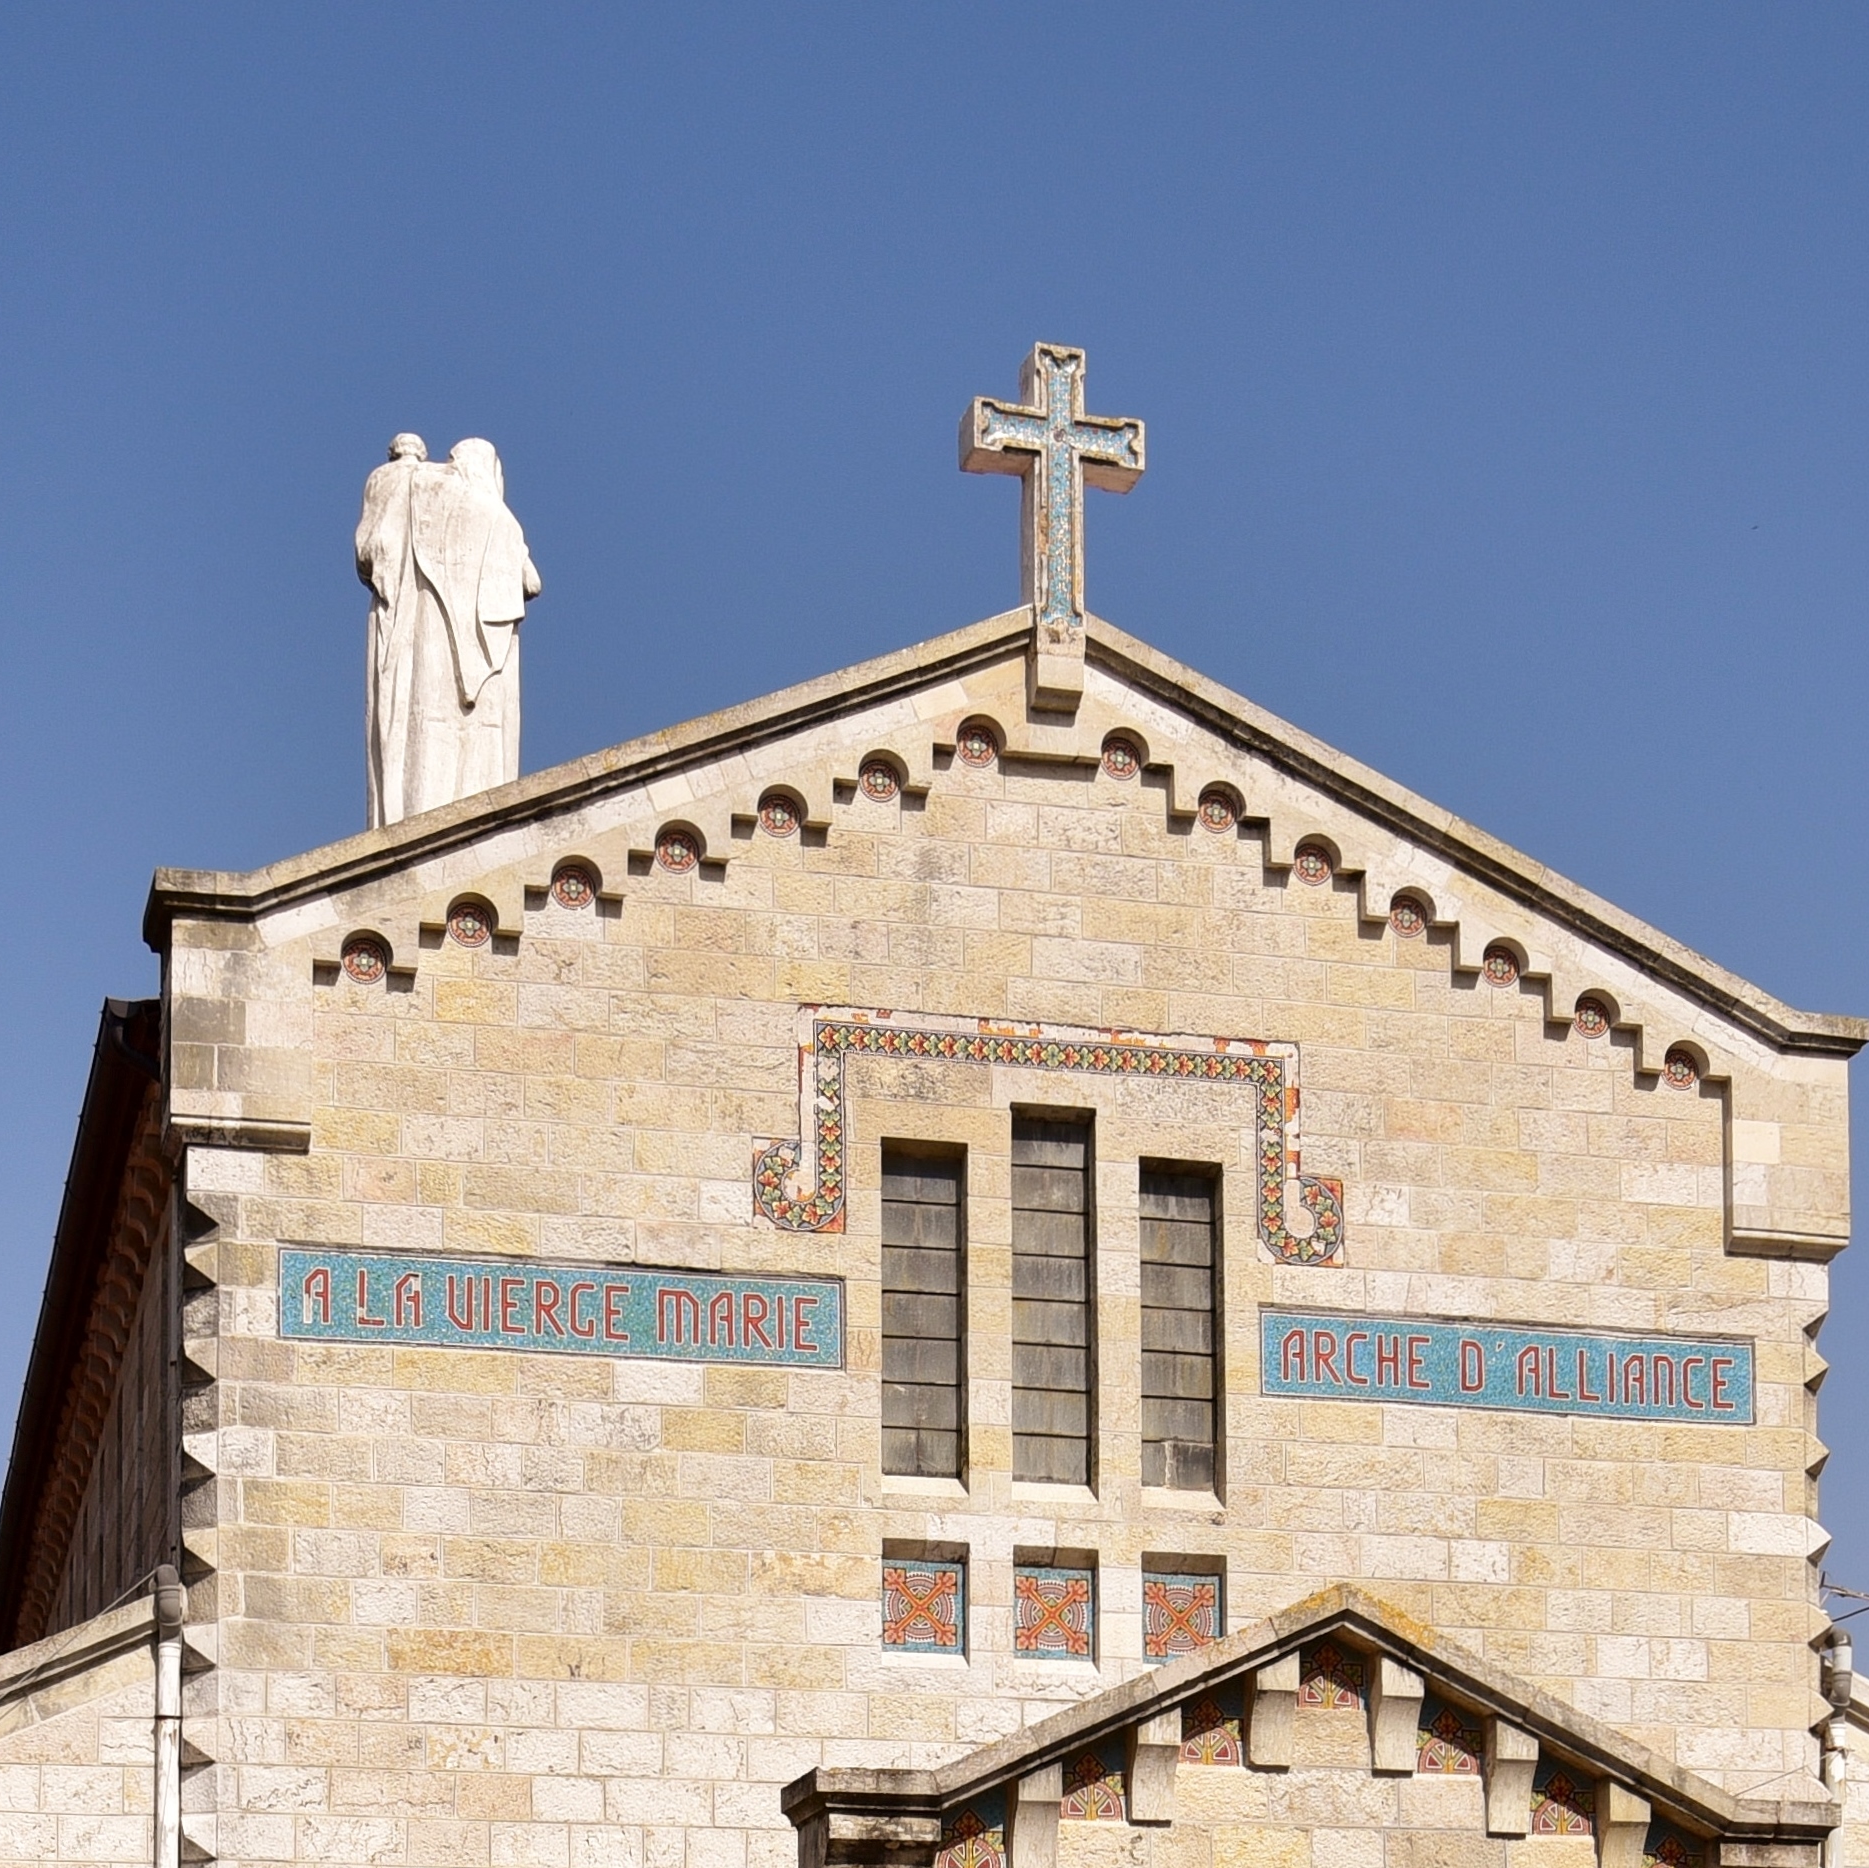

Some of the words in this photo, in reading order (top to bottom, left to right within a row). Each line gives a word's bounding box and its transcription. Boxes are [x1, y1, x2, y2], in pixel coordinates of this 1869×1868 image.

[302, 1267, 331, 1325] A
[357, 1269, 422, 1328] LA
[447, 1274, 631, 1342] VIERGE
[657, 1288, 820, 1352] MARIE
[1281, 1328, 1432, 1390] ARCHE
